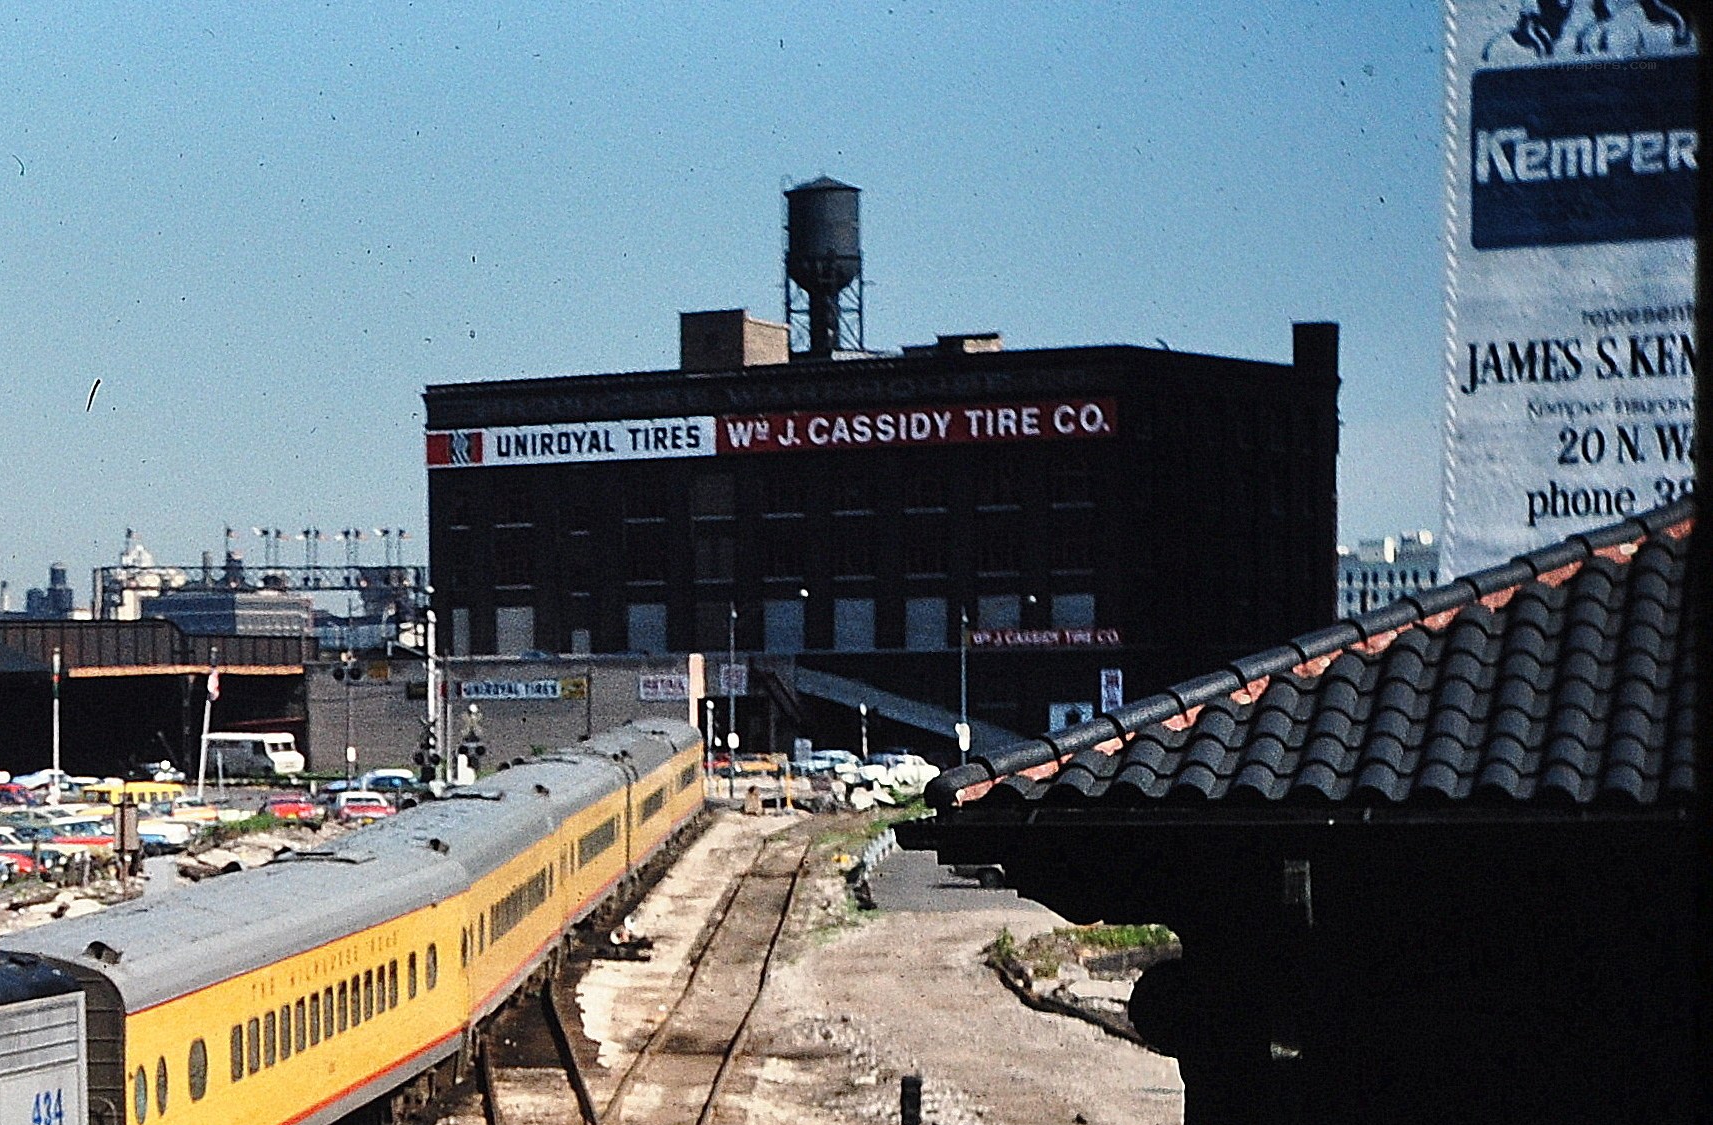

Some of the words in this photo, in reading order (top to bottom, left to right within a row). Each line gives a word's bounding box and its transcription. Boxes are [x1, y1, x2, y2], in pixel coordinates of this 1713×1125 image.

[1460, 338, 1583, 394] JAMES
[497, 428, 614, 457] UNIROYAL
[628, 424, 700, 452] TIRES
[778, 419, 801, 446] J.
[807, 411, 951, 446] CASSIDY
[965, 406, 1041, 438] TIRE
[1053, 403, 1110, 434] CO.
[1558, 425, 1606, 465] 20
[1527, 480, 1637, 527] phone
